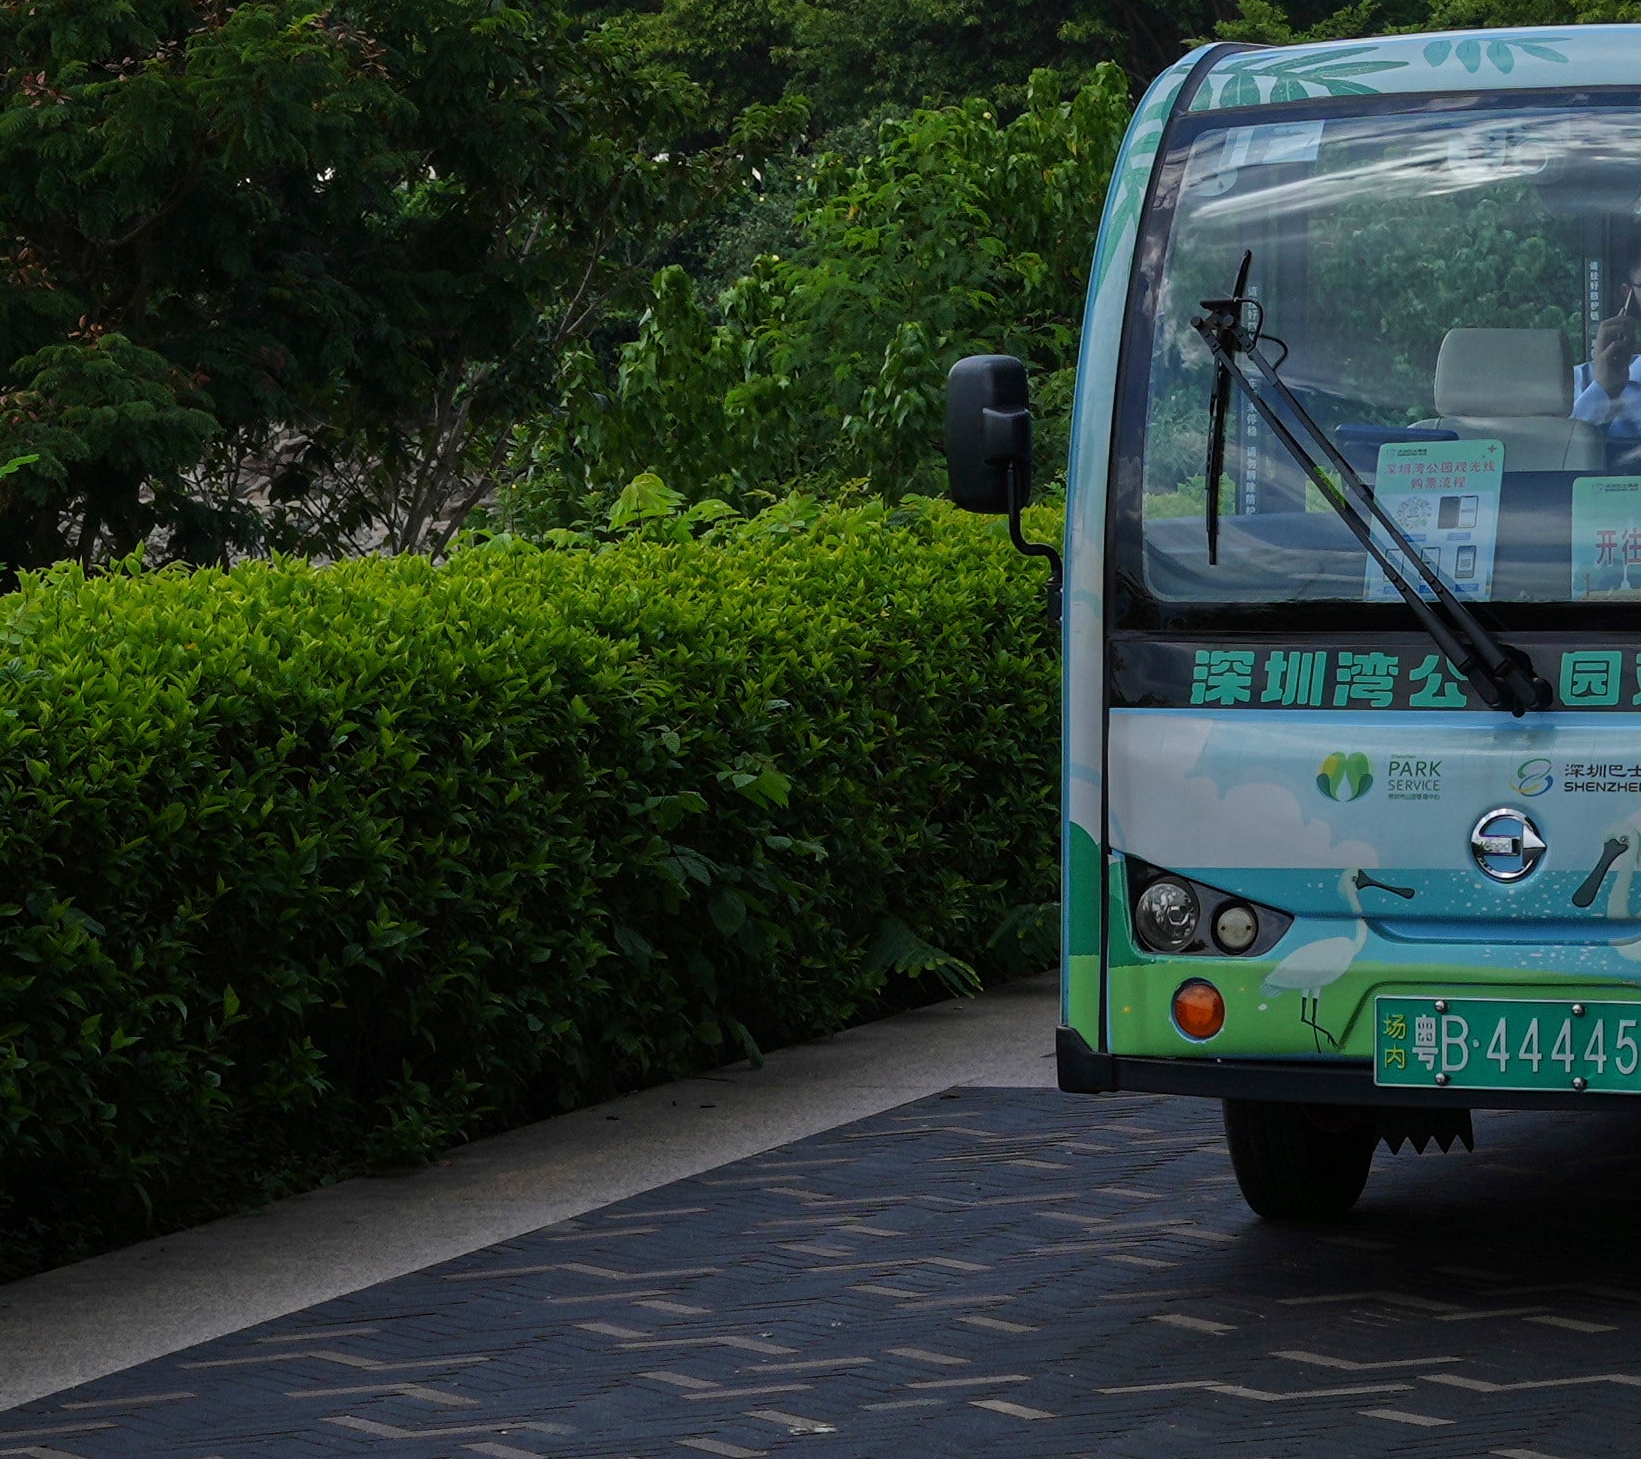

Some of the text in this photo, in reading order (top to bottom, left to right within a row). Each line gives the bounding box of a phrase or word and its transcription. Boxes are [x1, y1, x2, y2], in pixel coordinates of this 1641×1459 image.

[1388, 760, 1442, 777] PARK
[1388, 779, 1441, 791] SERVICE
[1383, 1014, 1407, 1070] 场内
